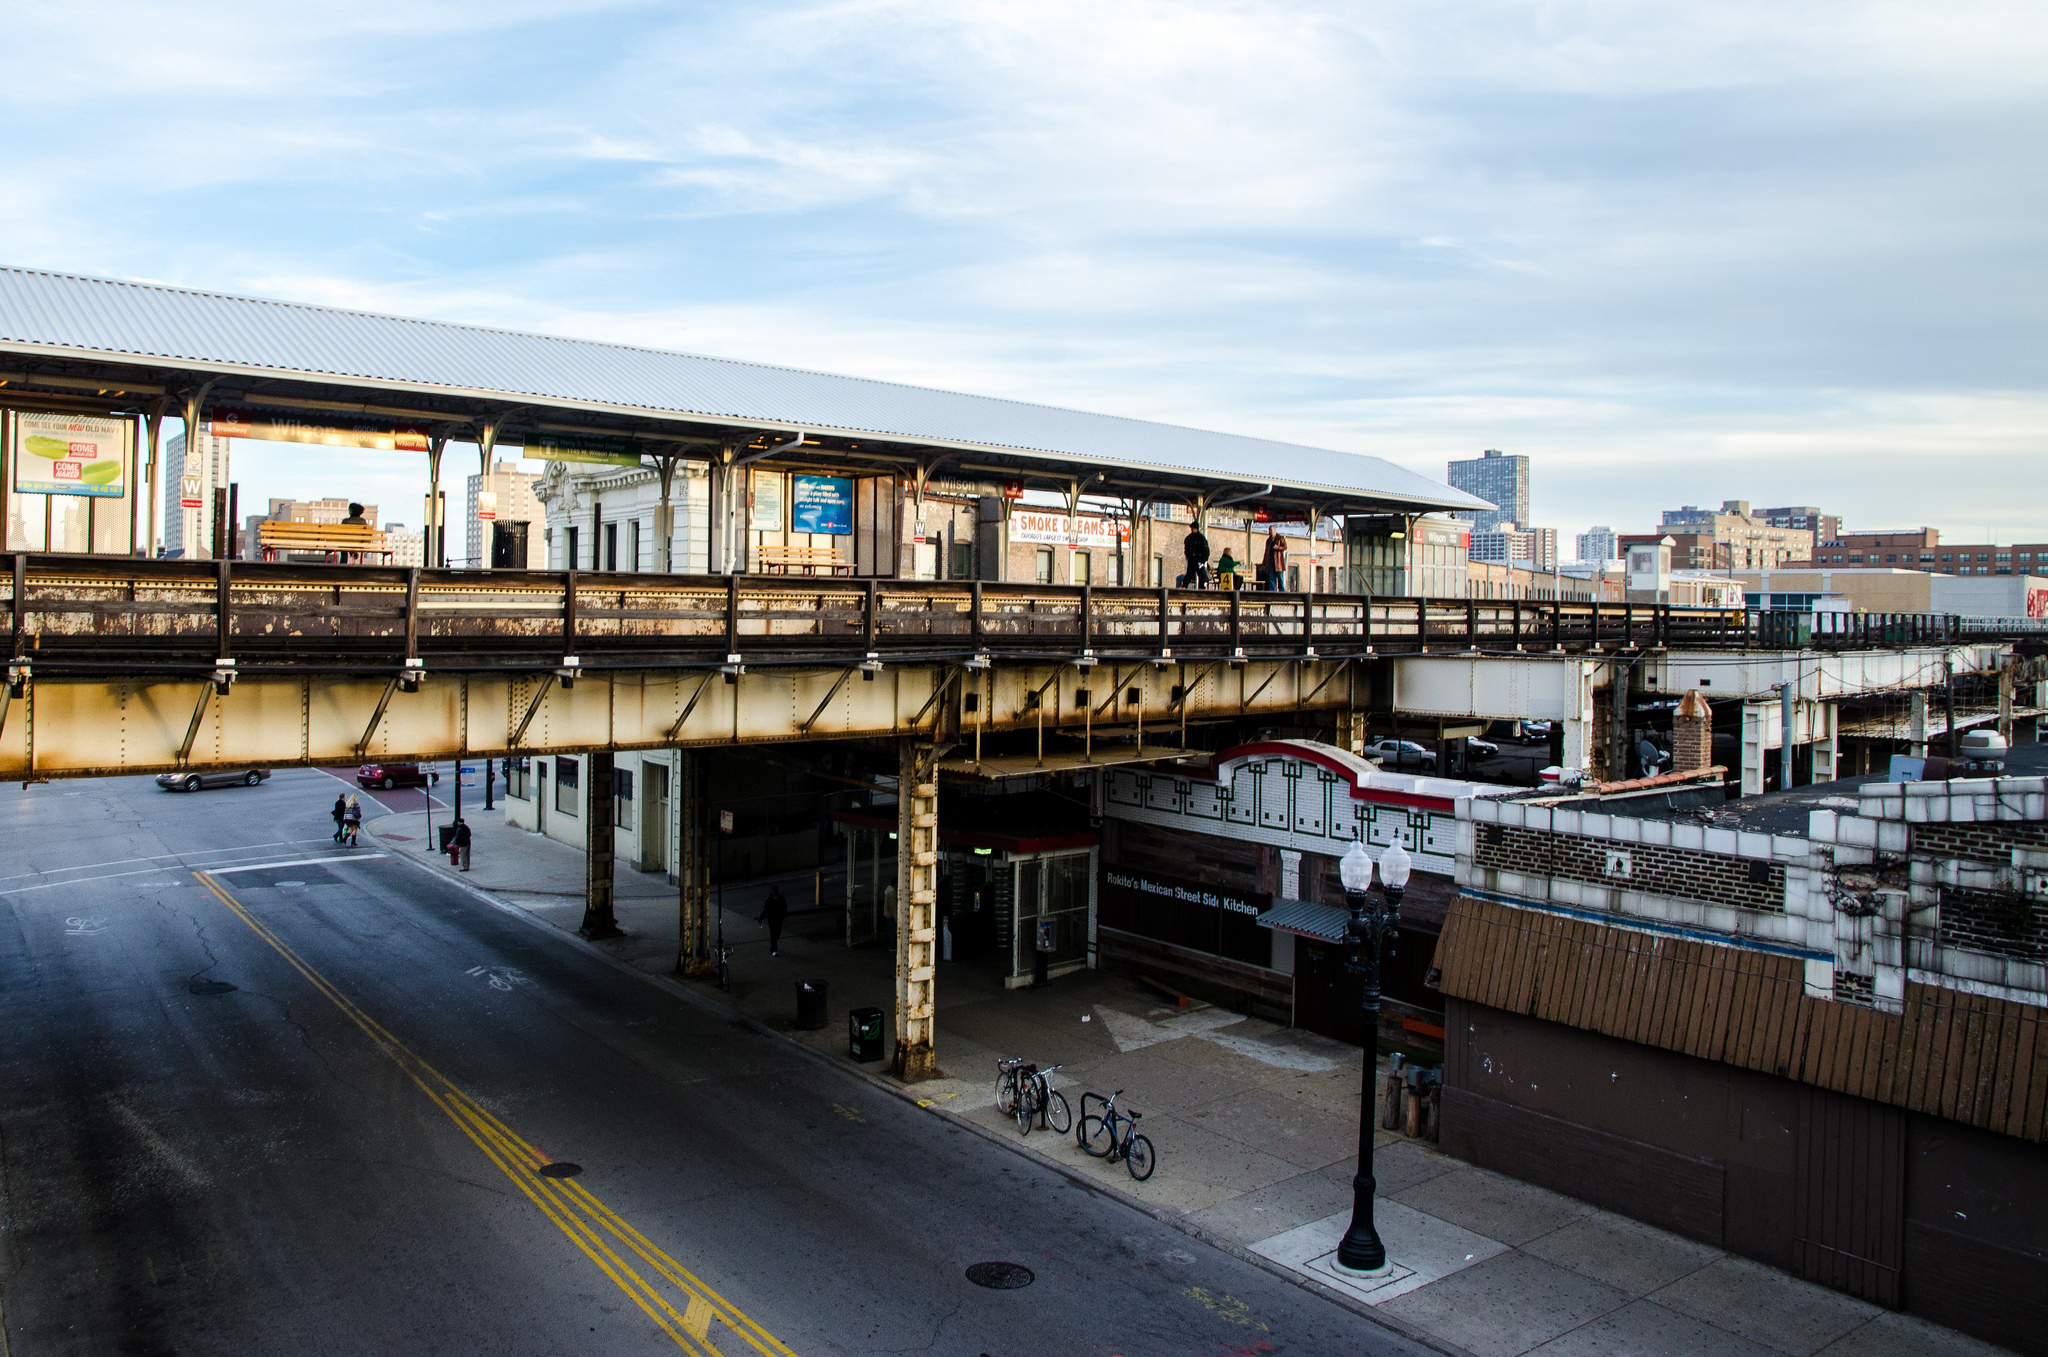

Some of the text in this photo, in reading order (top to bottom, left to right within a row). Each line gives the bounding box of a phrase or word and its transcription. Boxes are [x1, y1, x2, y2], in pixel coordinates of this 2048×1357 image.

[24, 420, 40, 428] COME
[41, 421, 51, 430] SEE
[52, 422, 67, 430] YOUR
[85, 424, 99, 432] OLD
[101, 426, 120, 434] NAVY
[215, 424, 248, 434] Broadway
[271, 417, 336, 438] Wilson
[71, 443, 95, 453] COME
[55, 462, 80, 472] COME
[55, 470, 79, 478] NAKED
[183, 479, 201, 494] W
[940, 475, 975, 491] Wilson
[915, 521, 925, 534] W
[1020, 515, 1105, 536] SMOKE DEAMS
[1428, 531, 1446, 543] Wilson
[1223, 574, 1230, 585] 4
[1107, 872, 1139, 889] Rokito's
[1140, 879, 1173, 897] Mexican
[1175, 886, 1201, 903] Street
[1223, 897, 1258, 916] Kitchen
